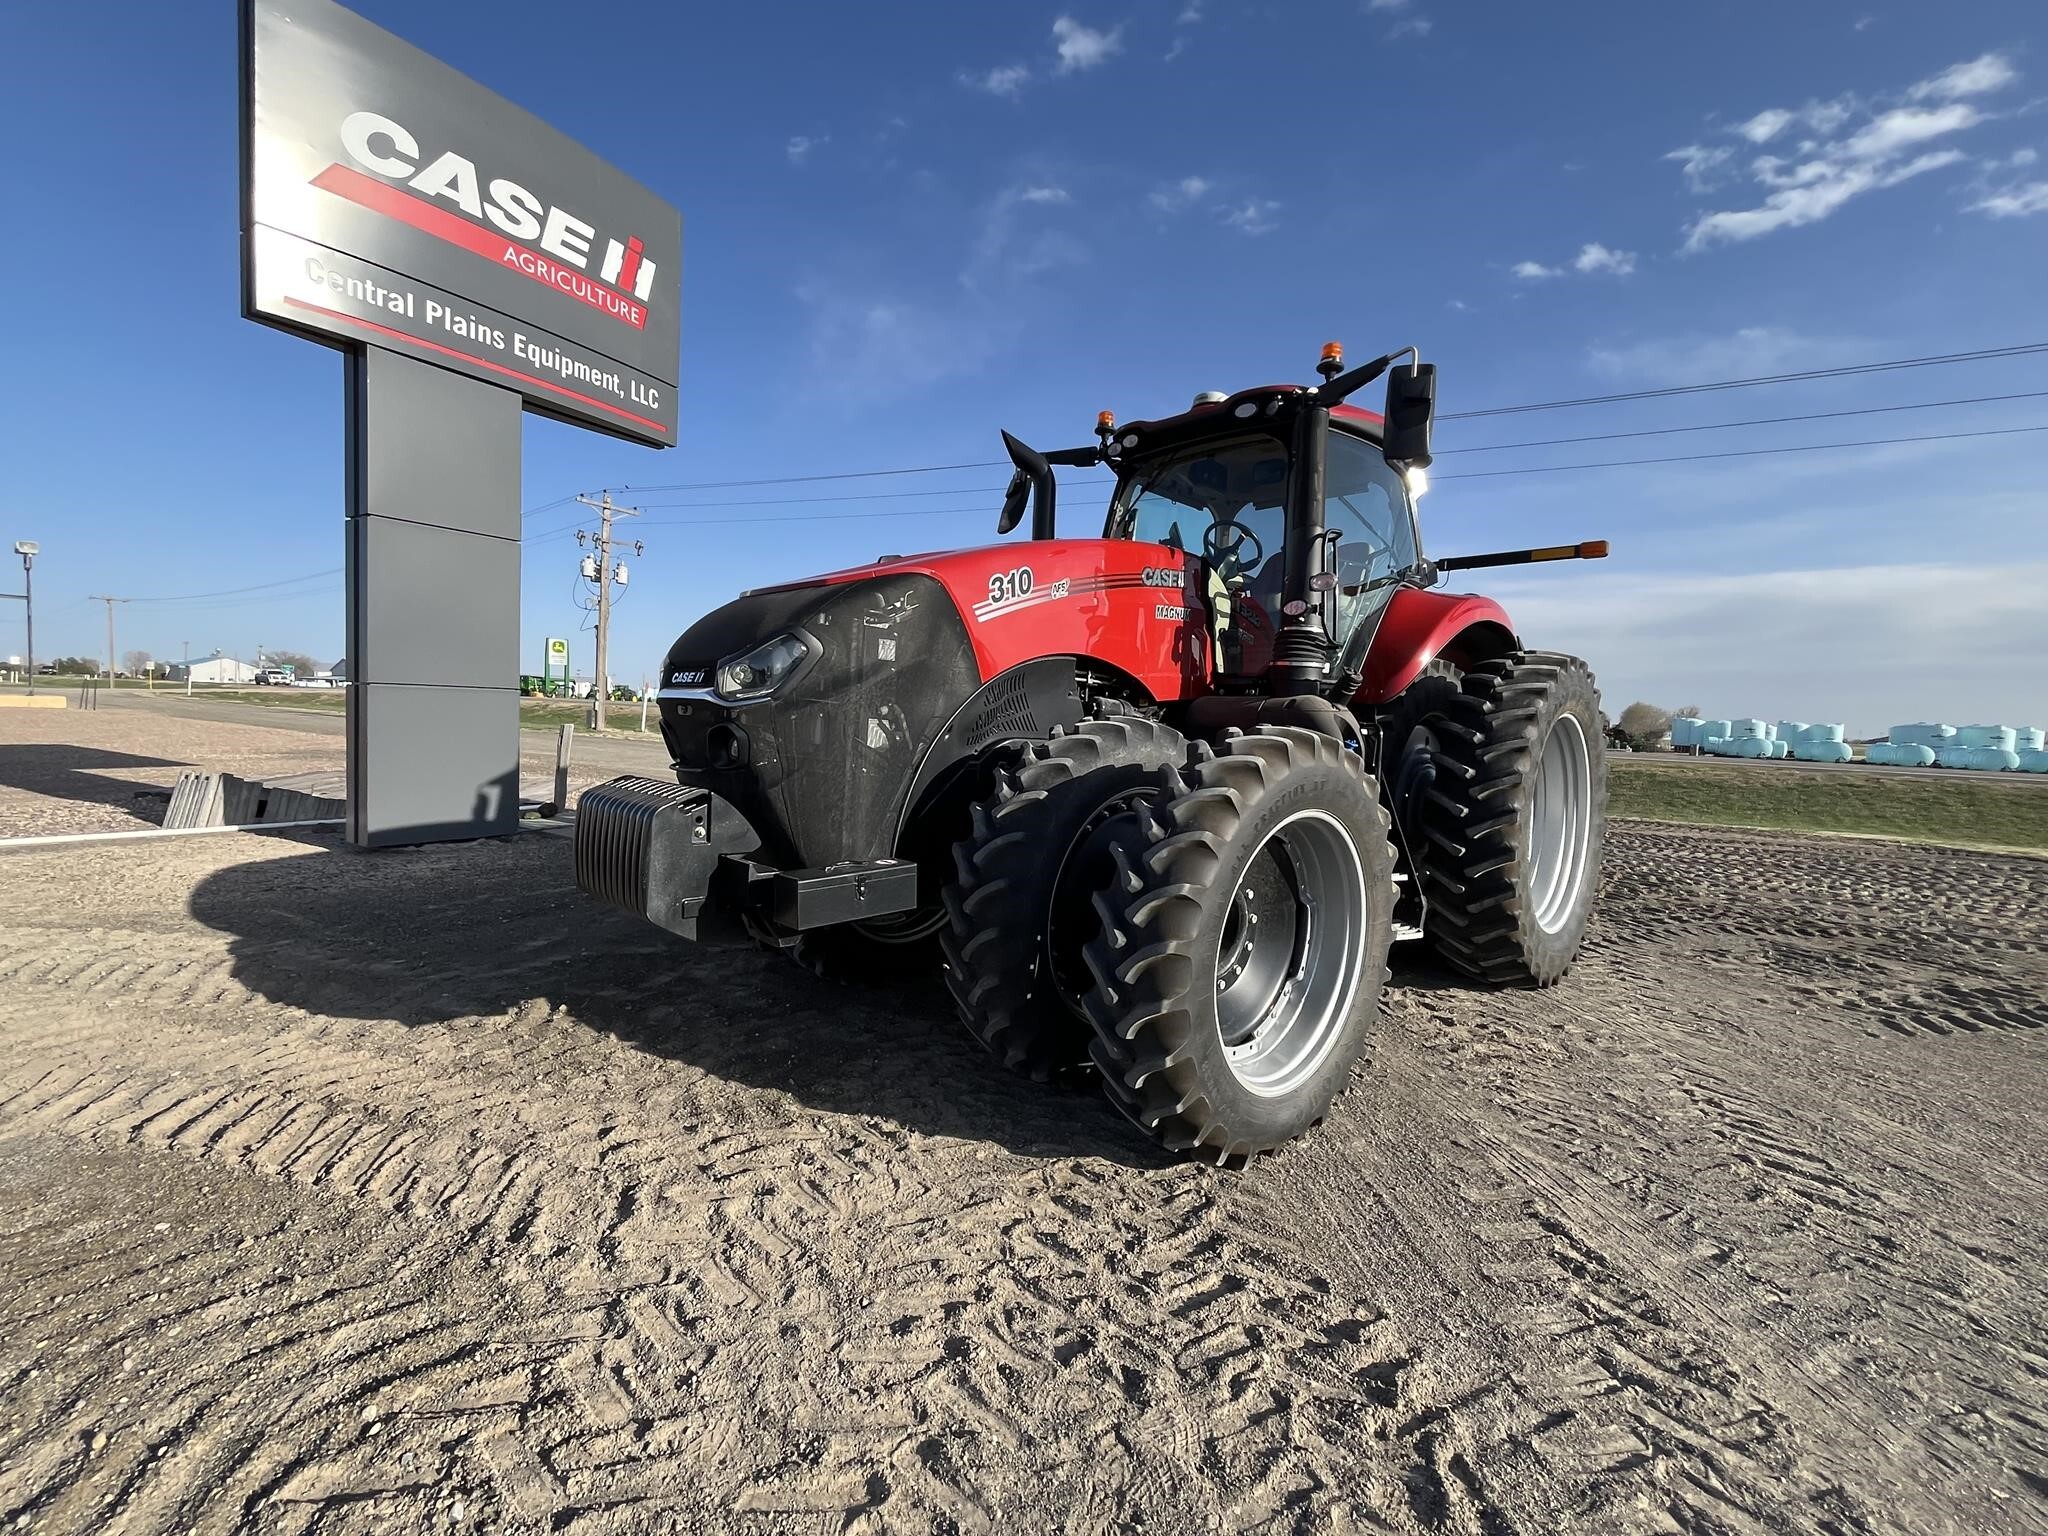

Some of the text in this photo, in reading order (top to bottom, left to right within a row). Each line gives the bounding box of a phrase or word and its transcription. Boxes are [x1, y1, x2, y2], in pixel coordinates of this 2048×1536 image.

[340, 111, 596, 269] CASE
[503, 246, 640, 325] AGRICULTURE
[305, 258, 659, 410] Central Plains Equipment, LLC
[989, 567, 1033, 605] 310
[1141, 567, 1179, 587] CASE
[1155, 604, 1191, 621] MAGNUM
[671, 671, 695, 683] CASE
